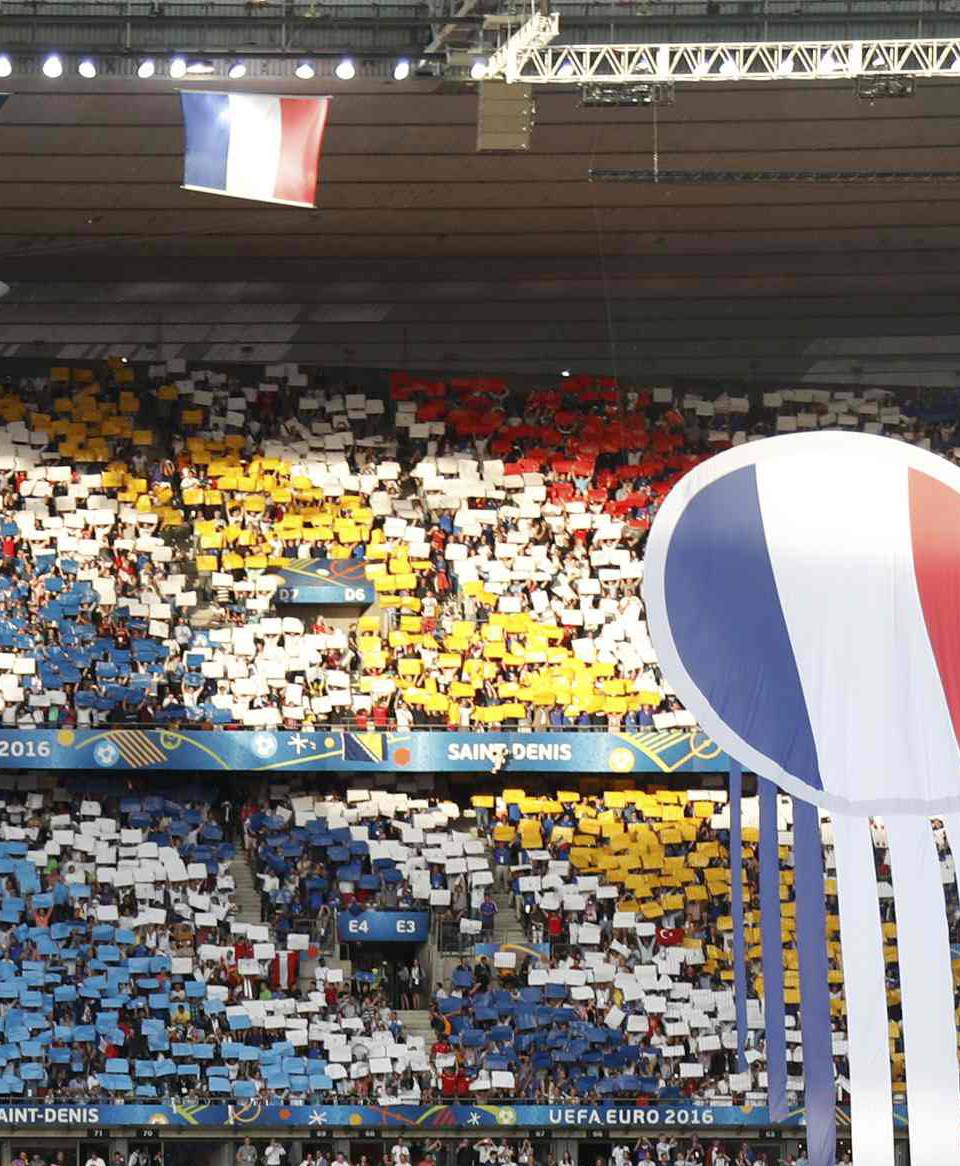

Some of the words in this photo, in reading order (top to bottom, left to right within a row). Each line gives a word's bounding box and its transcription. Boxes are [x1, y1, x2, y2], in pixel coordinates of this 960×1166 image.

[279, 588, 299, 601] D7
[344, 588, 366, 601] D6
[348, 920, 369, 933] E4
[396, 920, 416, 933] E3
[549, 1109, 601, 1124] UEFA
[606, 1109, 659, 1124] EURO
[664, 1109, 714, 1124] 2016
